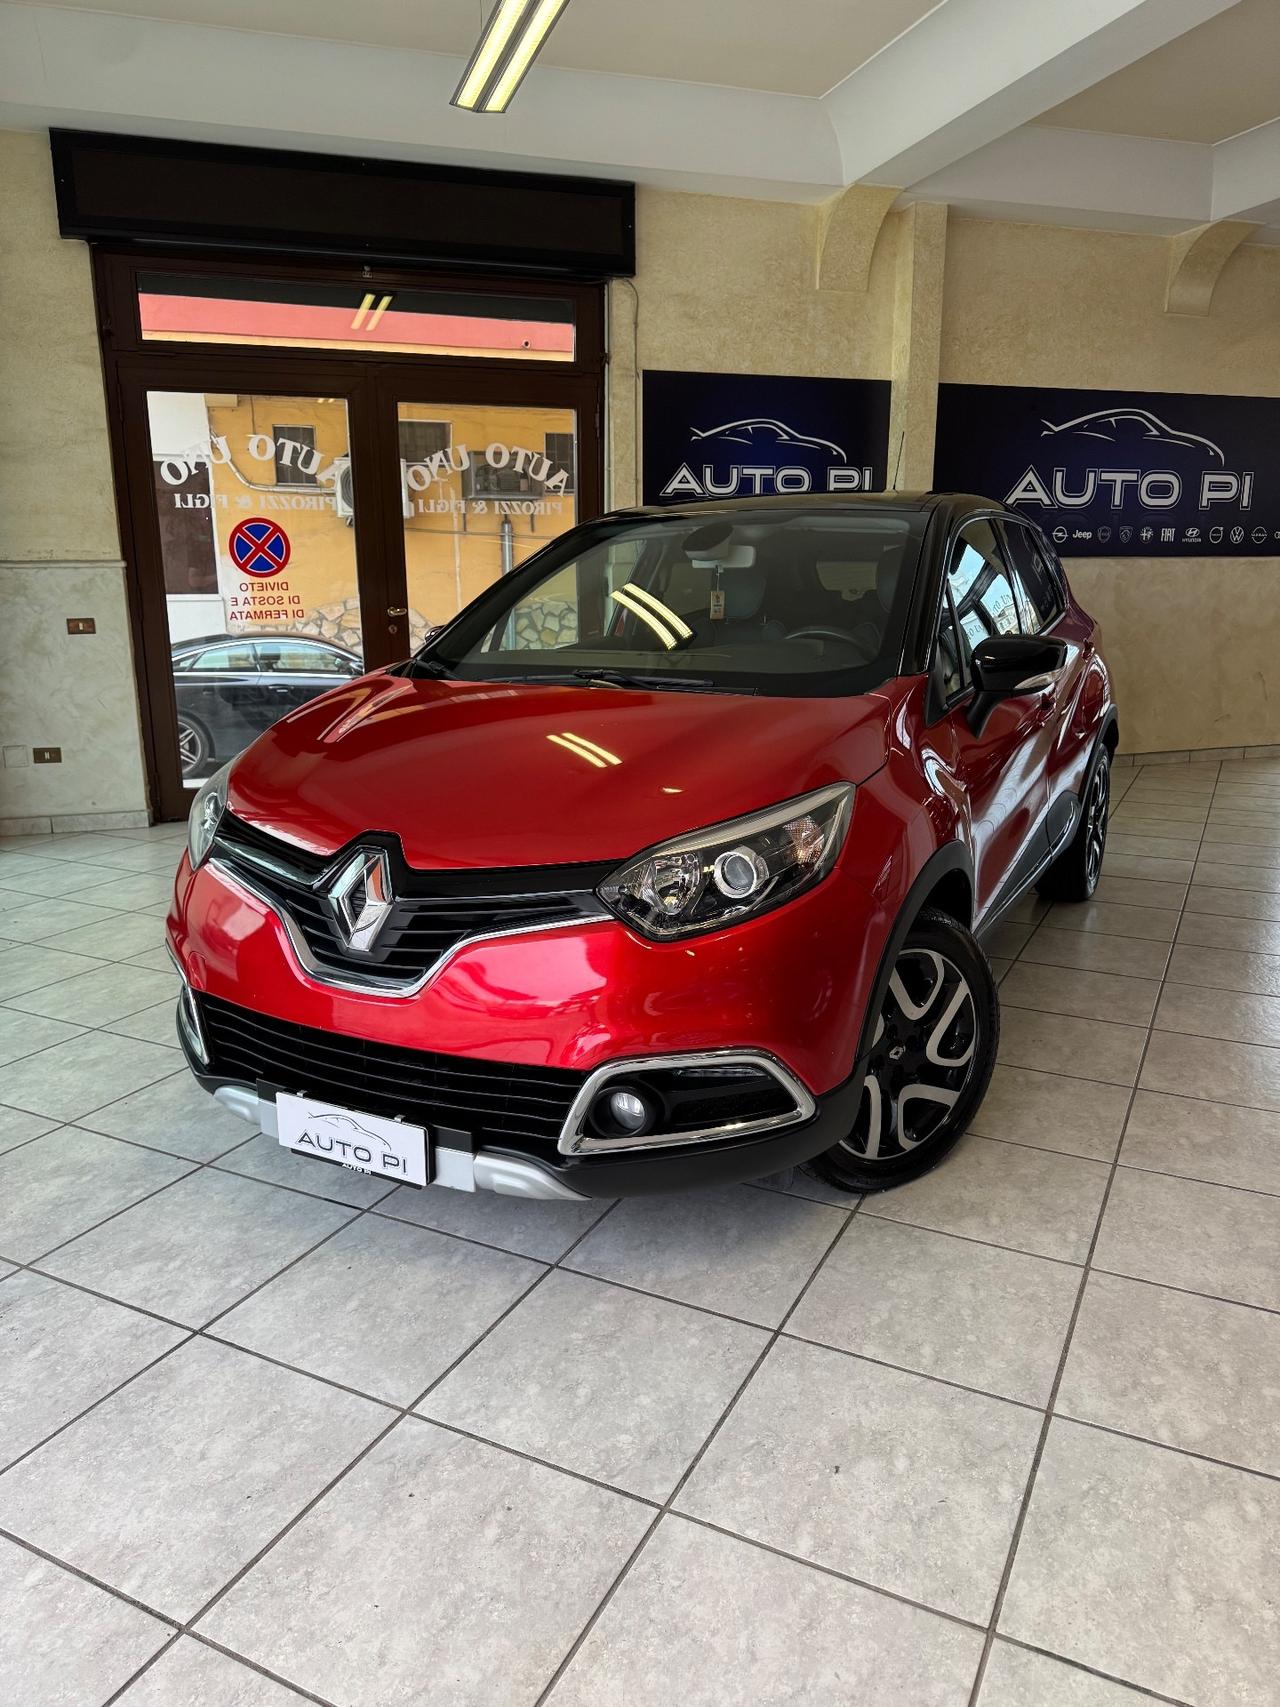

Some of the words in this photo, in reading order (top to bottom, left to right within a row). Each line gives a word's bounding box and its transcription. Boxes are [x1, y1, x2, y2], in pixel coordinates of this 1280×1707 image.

[659, 462, 813, 497] AUTO
[827, 466, 873, 491] PI
[1003, 464, 1183, 510] AUTO
[1198, 471, 1255, 511] PI
[1072, 530, 1093, 540] Jeep
[1160, 528, 1176, 543] FIAT
[296, 1129, 374, 1164] AUTO
[382, 1151, 408, 1175] PI
